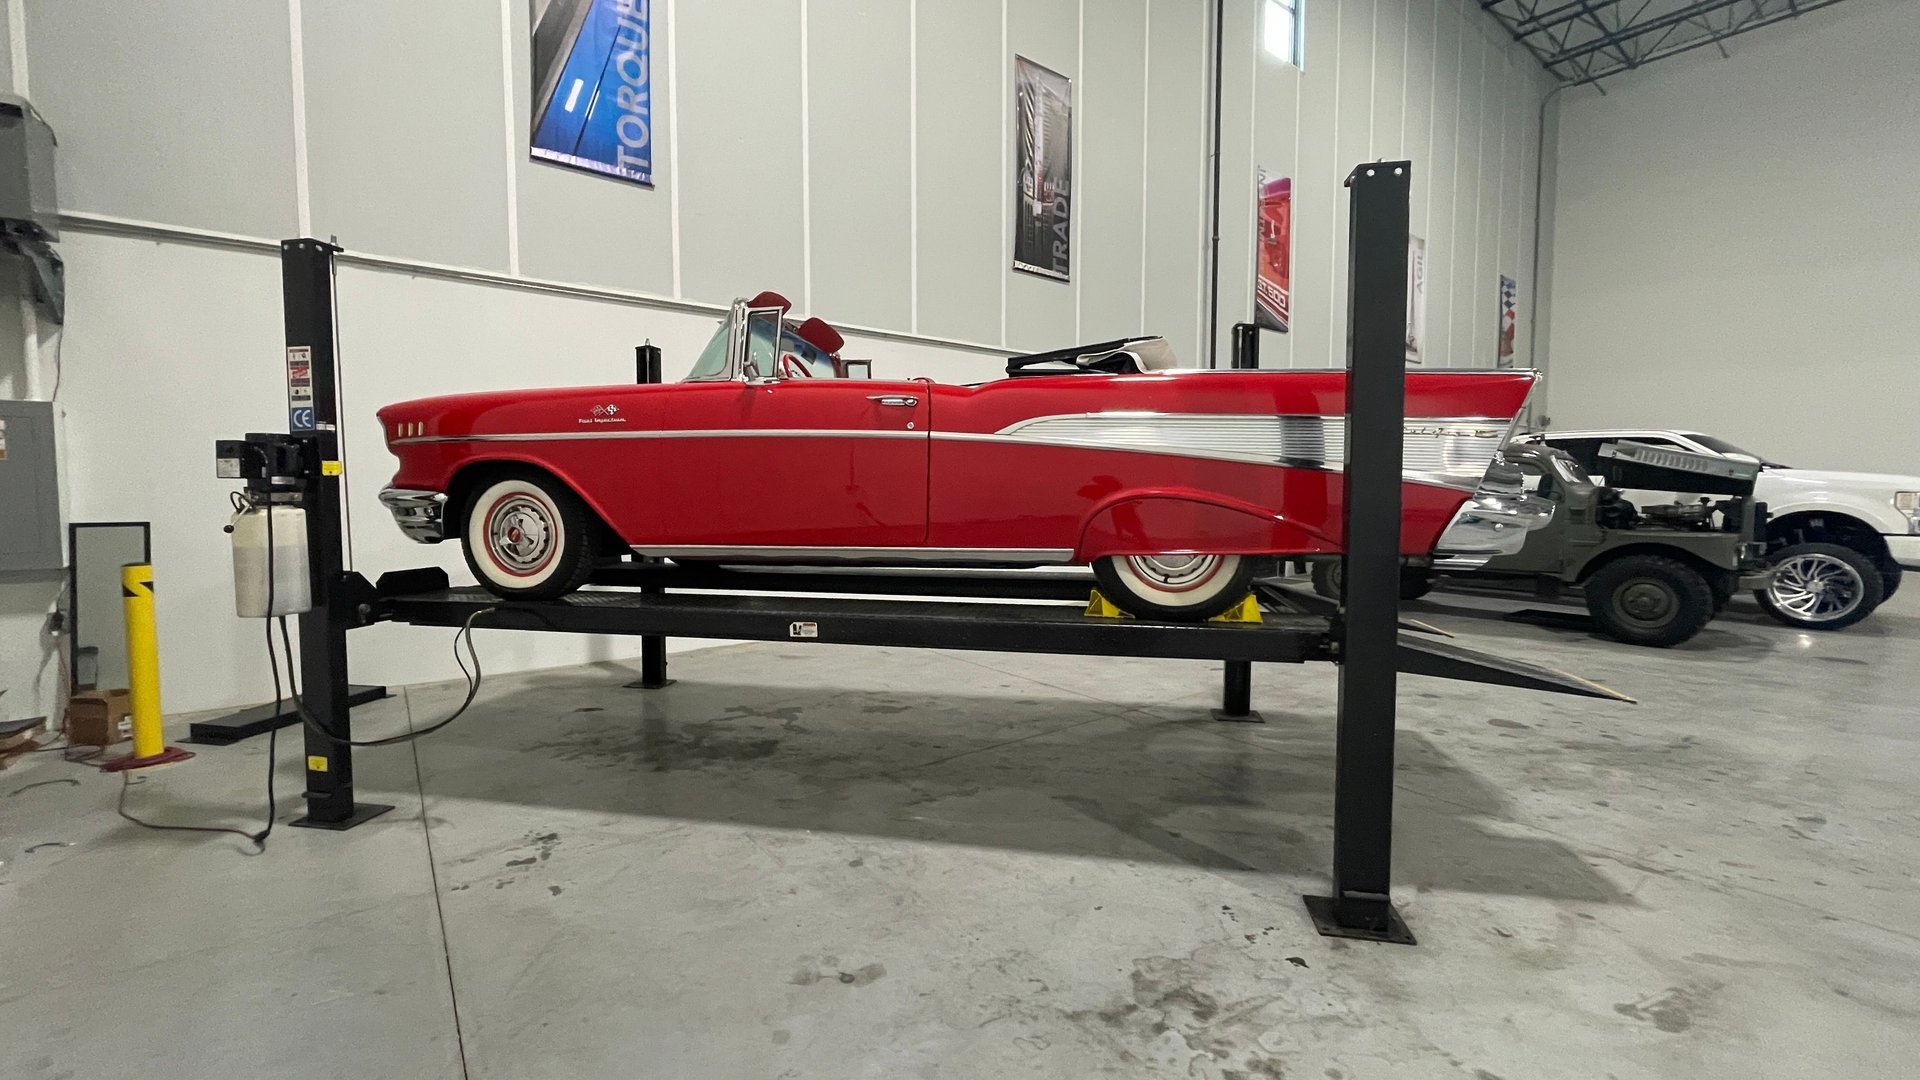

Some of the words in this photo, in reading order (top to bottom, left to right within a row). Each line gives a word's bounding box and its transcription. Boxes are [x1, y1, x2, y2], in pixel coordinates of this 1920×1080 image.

[616, 0, 649, 168] TORQUE
[1053, 176, 1070, 274] TRADE
[293, 409, 312, 428] CE
